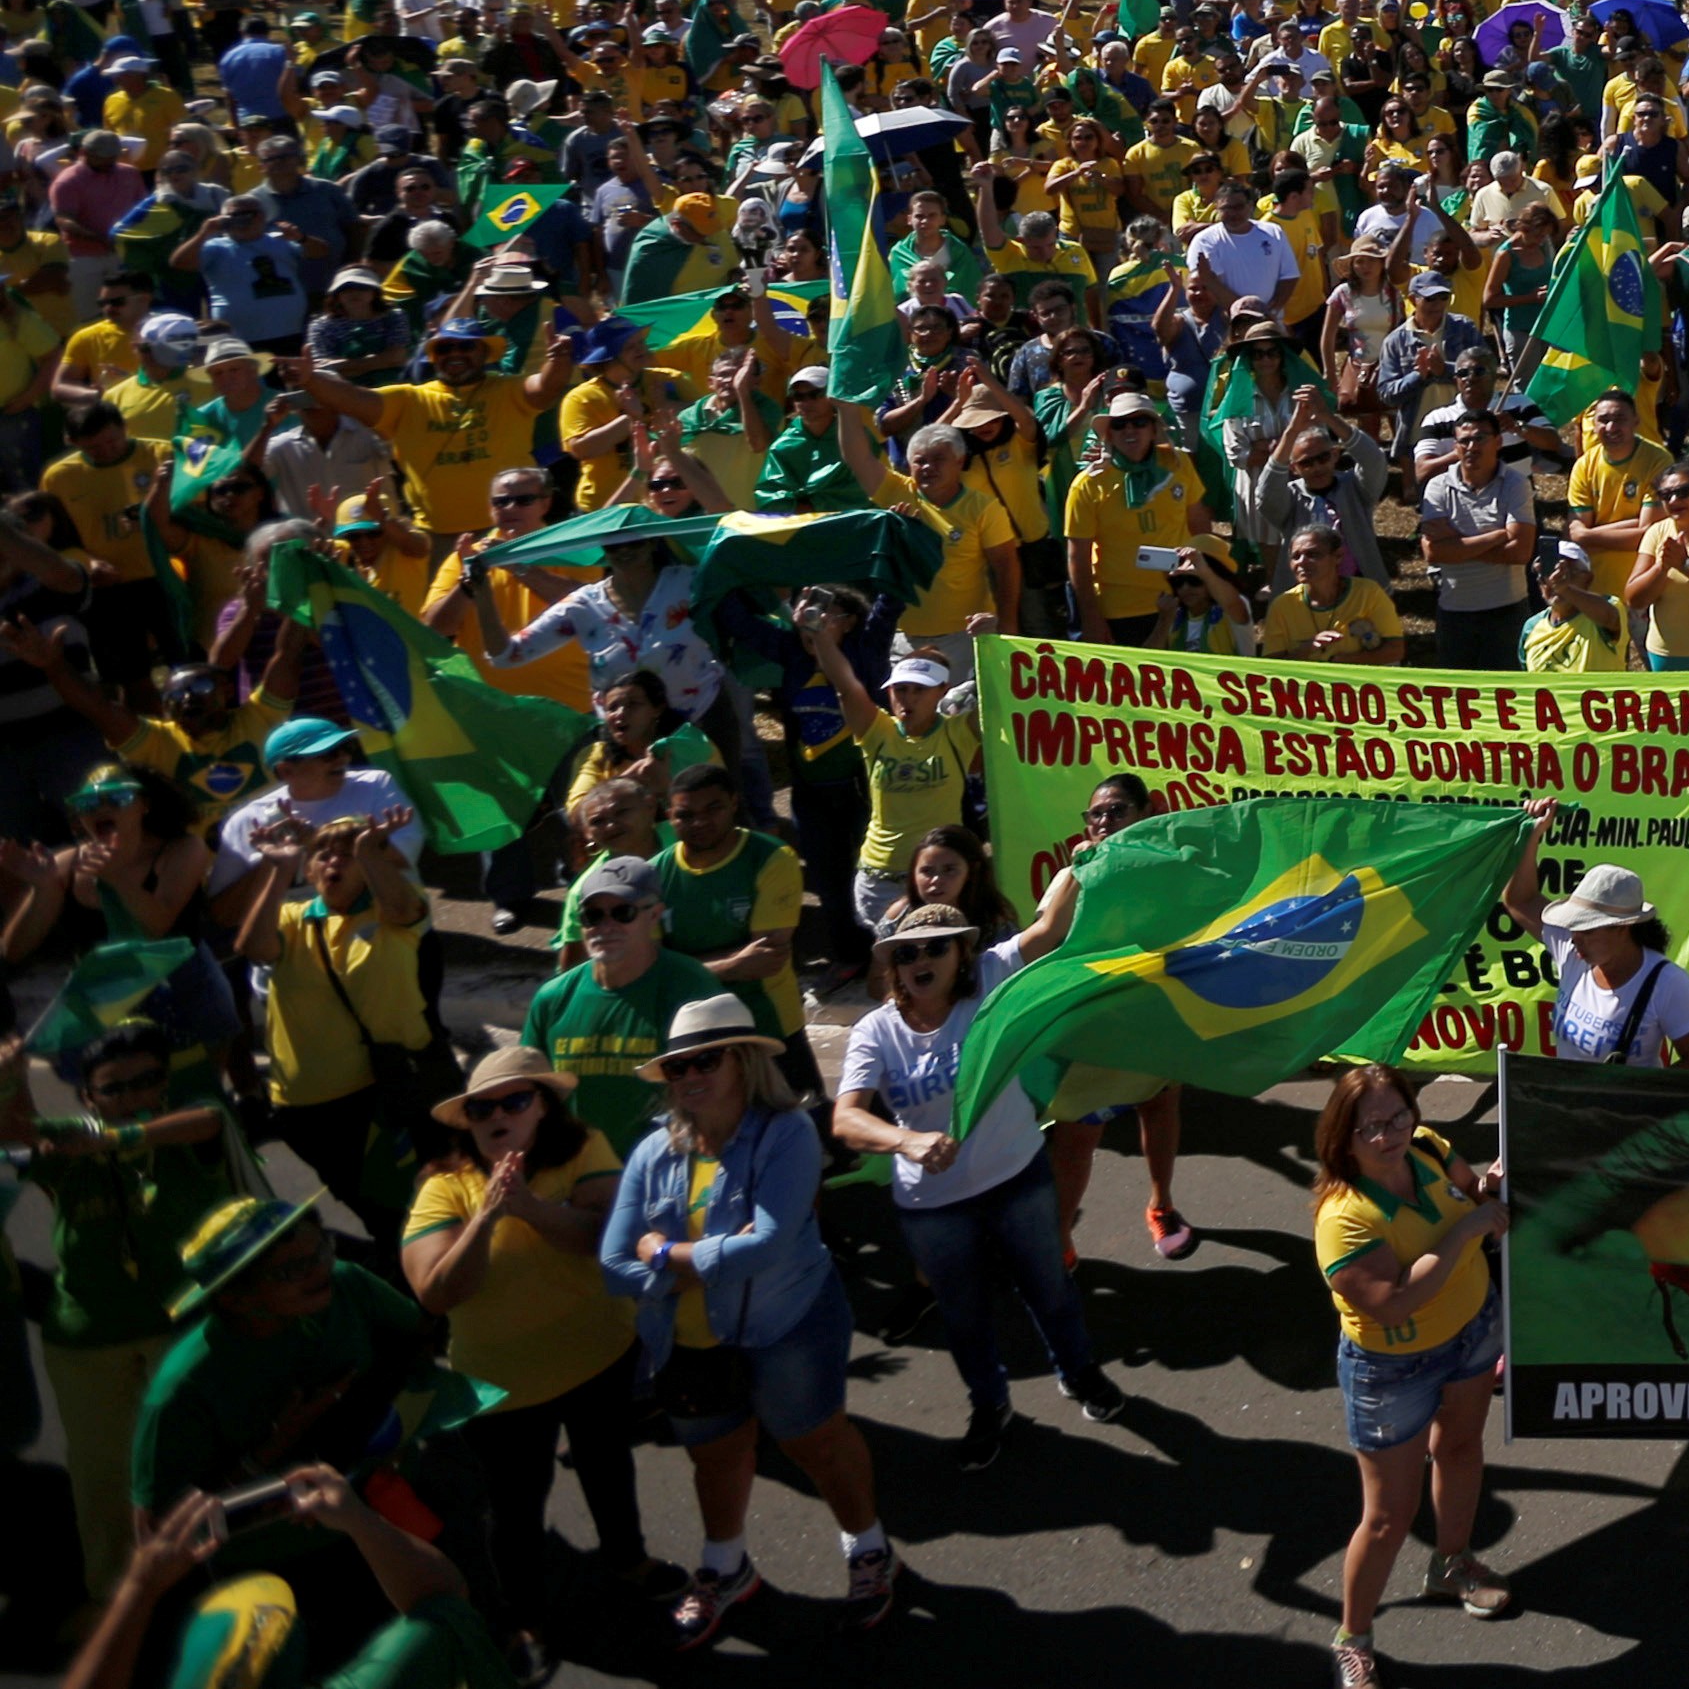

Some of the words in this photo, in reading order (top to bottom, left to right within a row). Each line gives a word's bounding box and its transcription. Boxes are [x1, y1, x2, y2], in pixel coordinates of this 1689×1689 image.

[1009, 642, 1213, 719] CÂMARA,
[1216, 670, 1398, 733] SENADO,
[1397, 682, 1482, 732] STF
[1494, 687, 1518, 731] E
[1534, 687, 1568, 733] A
[1010, 708, 1248, 776] IMPRENSA
[1259, 726, 1397, 781] ESTÃO
[1405, 739, 1566, 792] CONTRA
[1572, 742, 1600, 794] O
